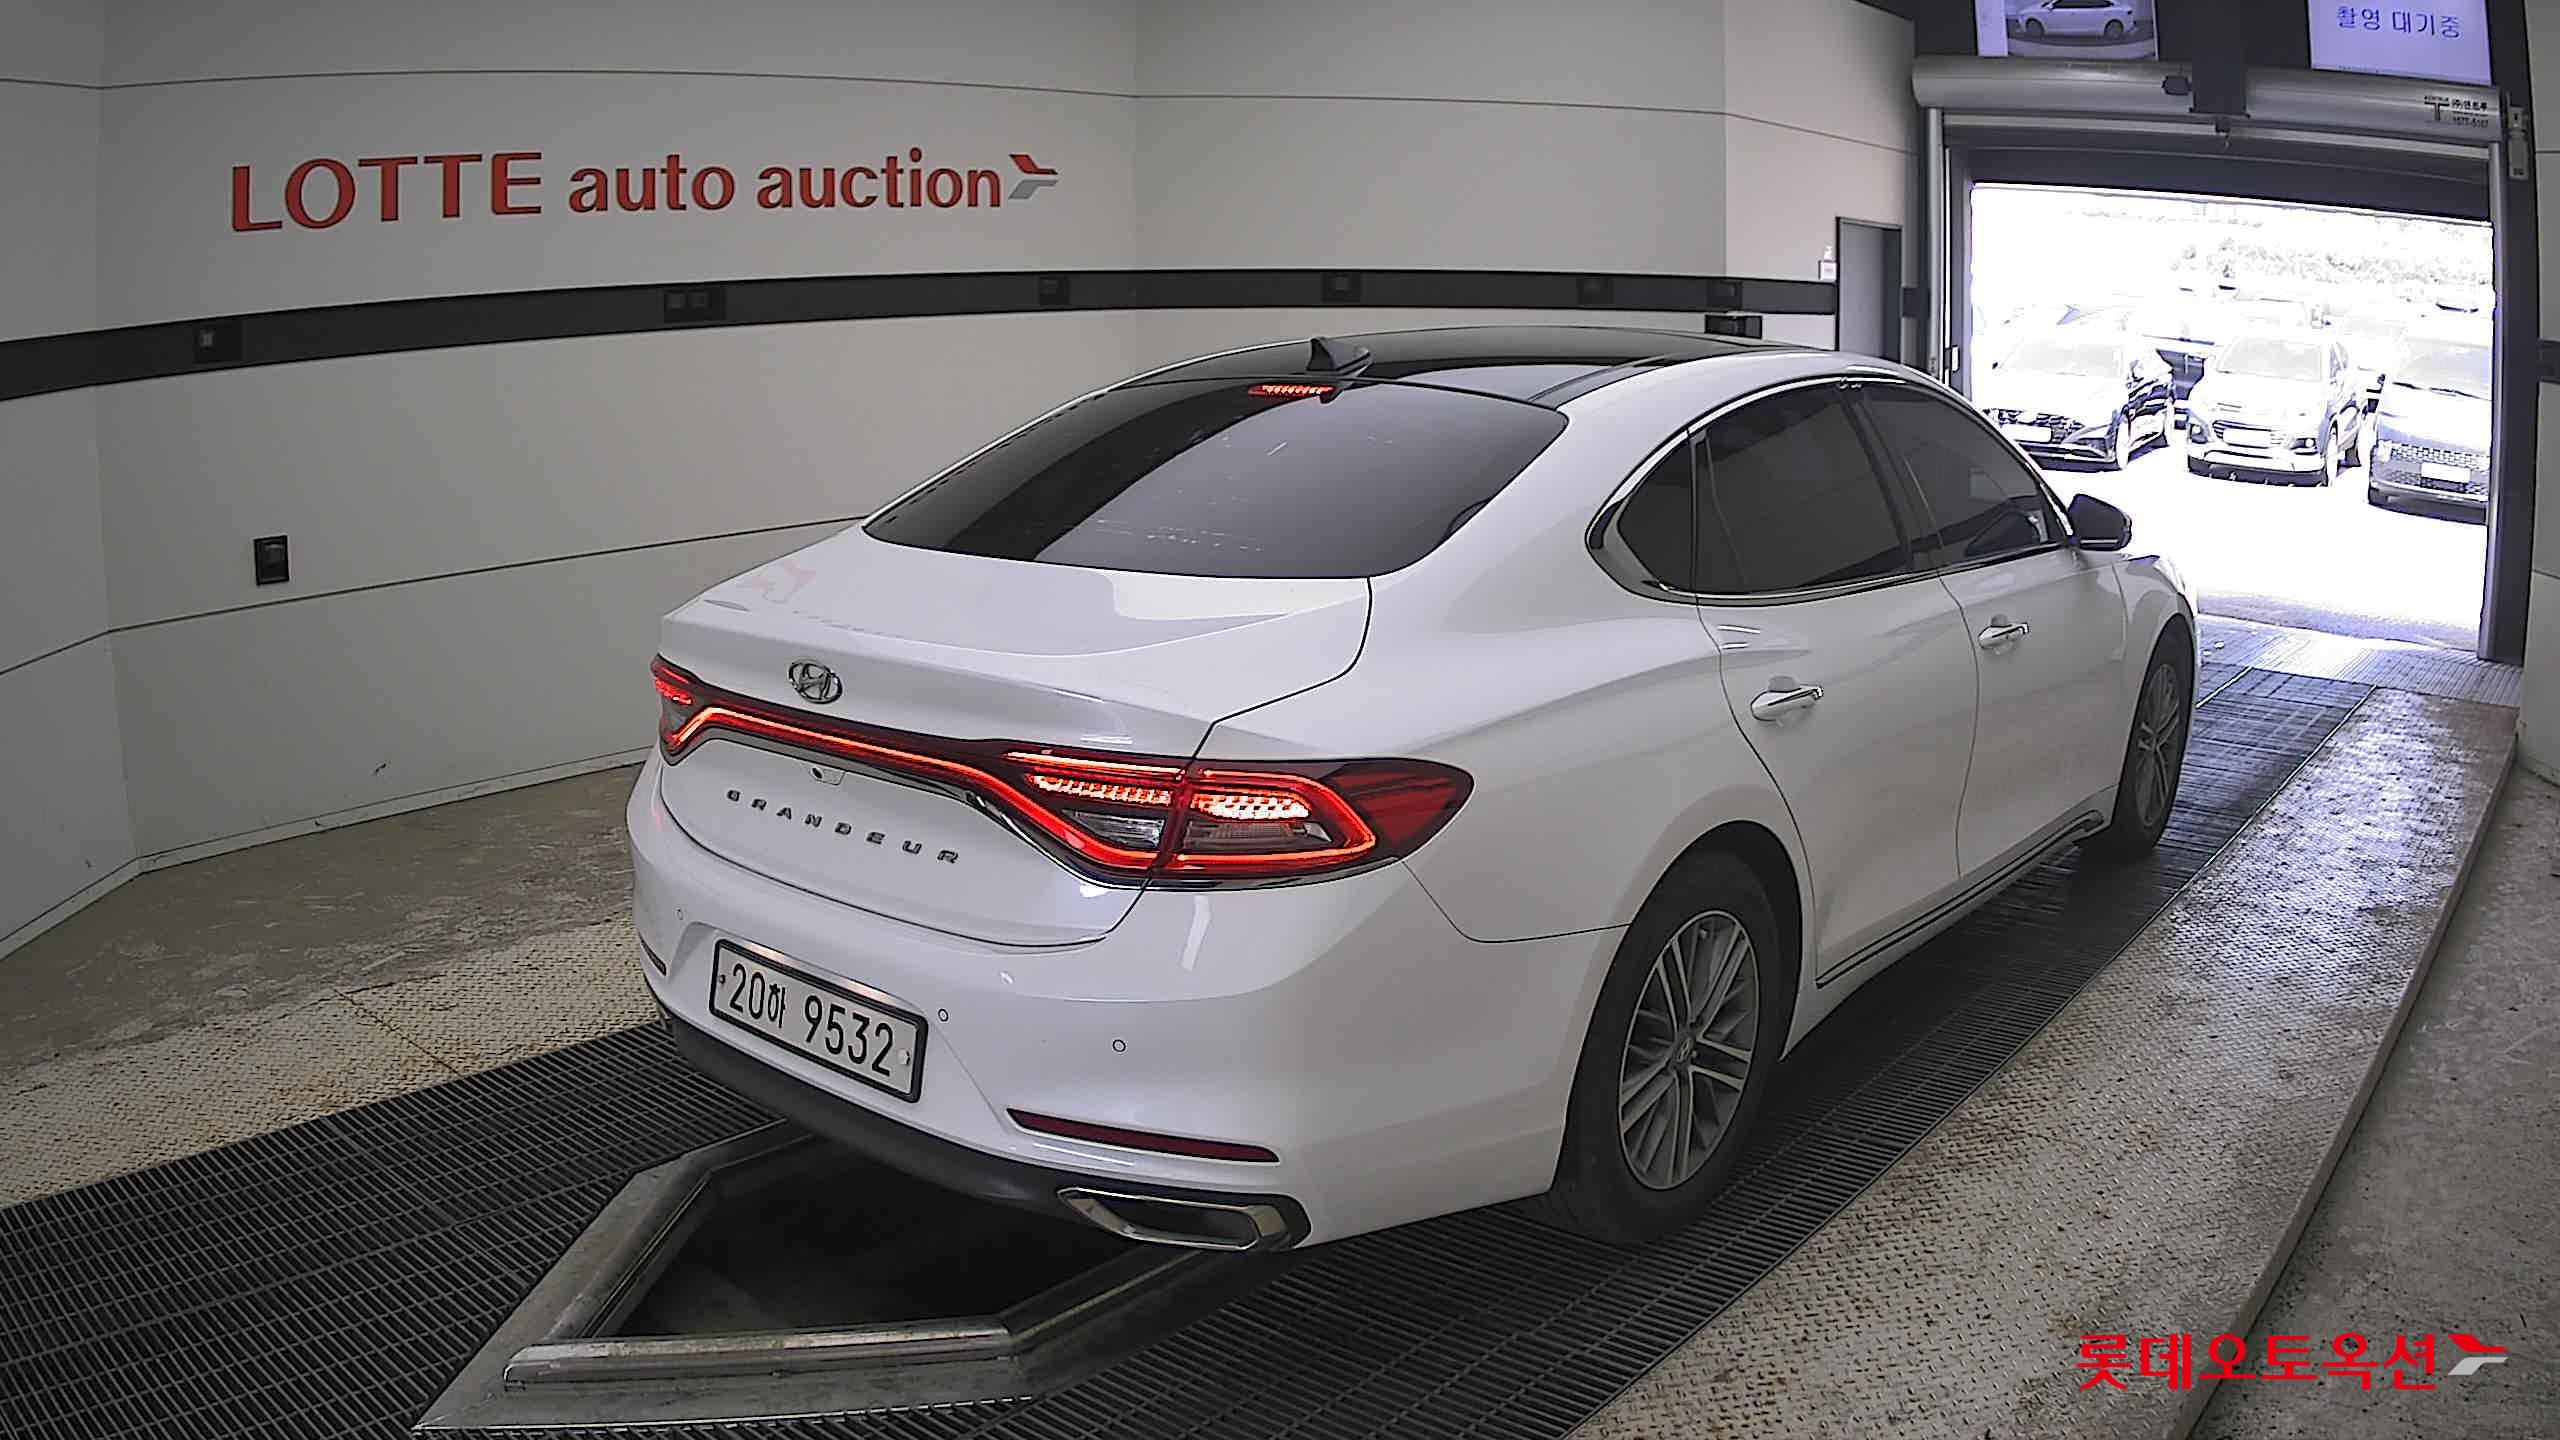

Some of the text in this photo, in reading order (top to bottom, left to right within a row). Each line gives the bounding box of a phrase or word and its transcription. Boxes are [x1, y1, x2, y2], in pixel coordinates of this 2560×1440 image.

[2337, 6, 2460, 39] 촬영 대기중
[231, 147, 1001, 232] LOTTE auto auction
[726, 789, 959, 864] GRANDEUR
[729, 963, 894, 1077] 20하 9532
